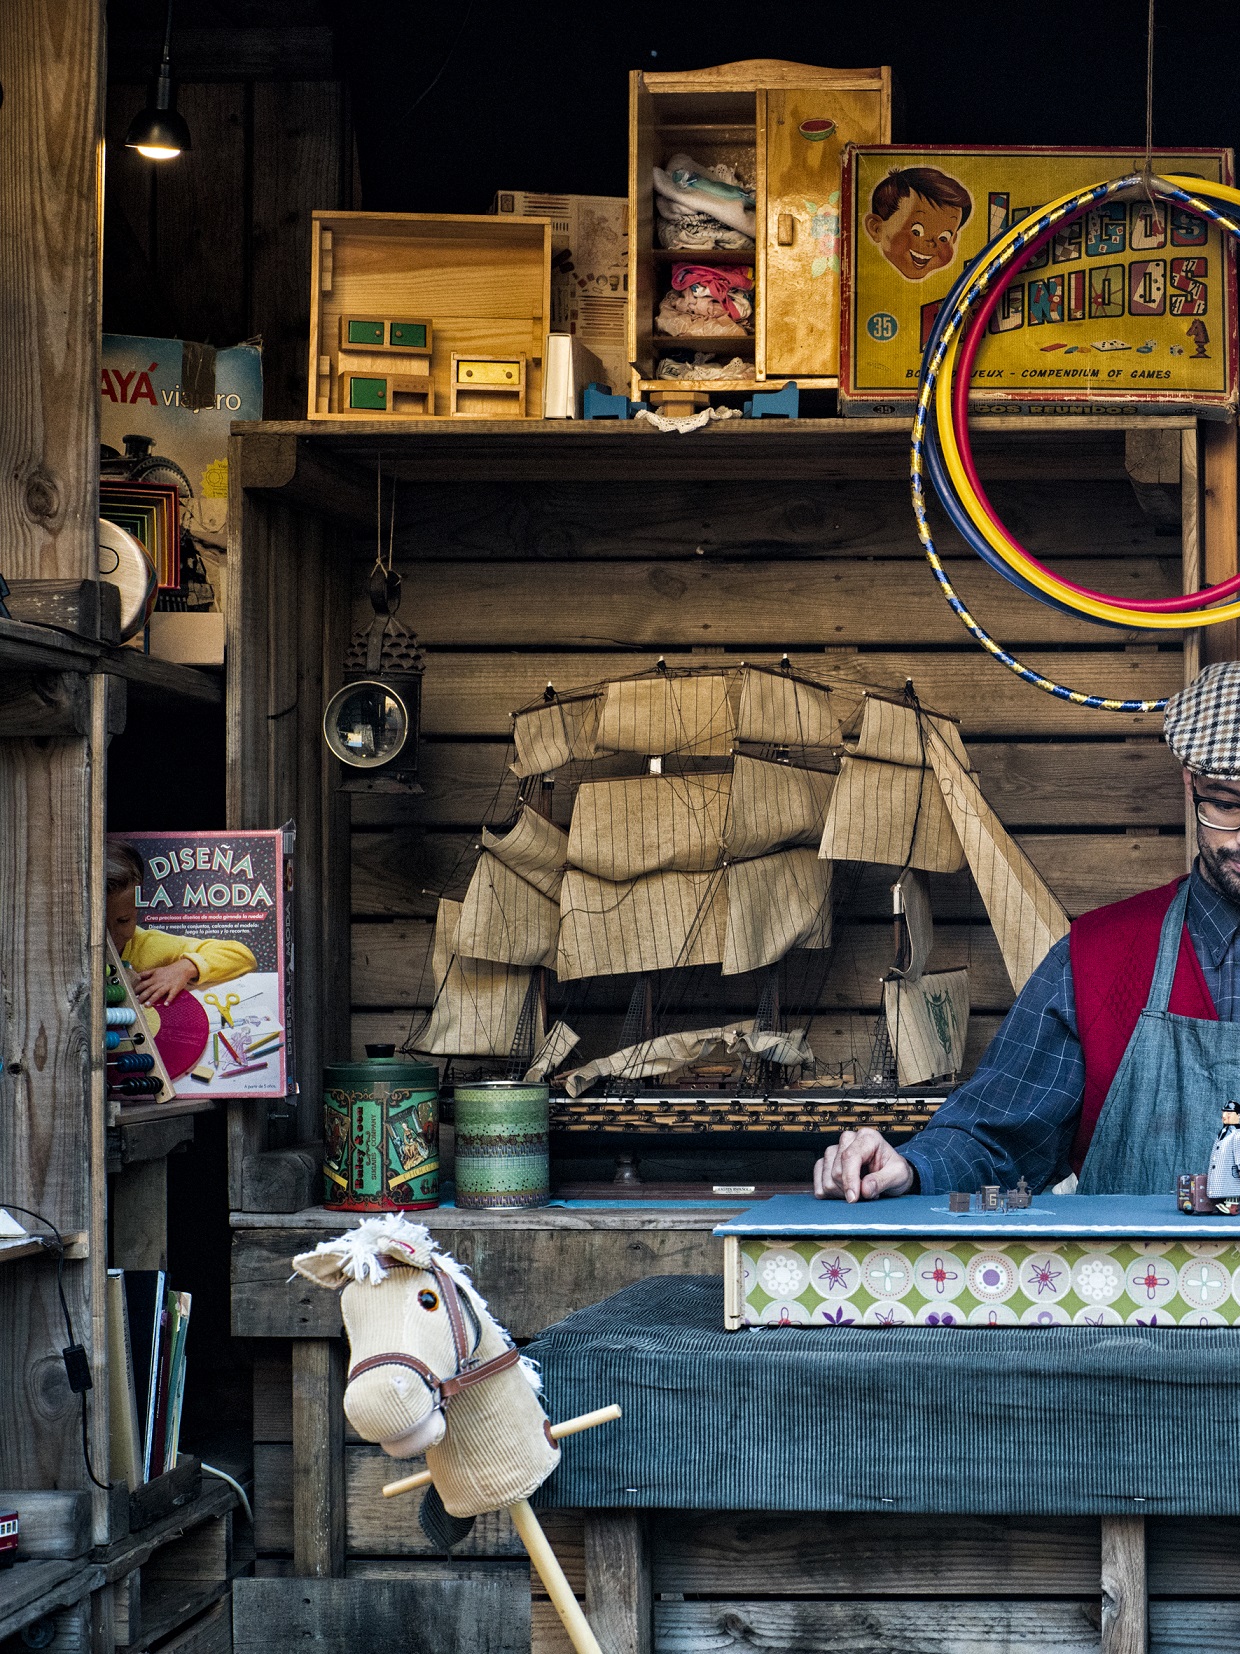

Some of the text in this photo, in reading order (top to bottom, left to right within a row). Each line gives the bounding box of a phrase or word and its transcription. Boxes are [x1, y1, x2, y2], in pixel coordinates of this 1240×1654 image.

[874, 317, 892, 337] 35
[100, 362, 159, 406] AYÁ
[1022, 369, 1099, 378] COMPENDIUM
[1130, 370, 1171, 379] GAMES
[1028, 405, 1138, 415] REUNIDOS
[149, 844, 254, 880] DISEÑA
[135, 883, 273, 908] LA MODA
